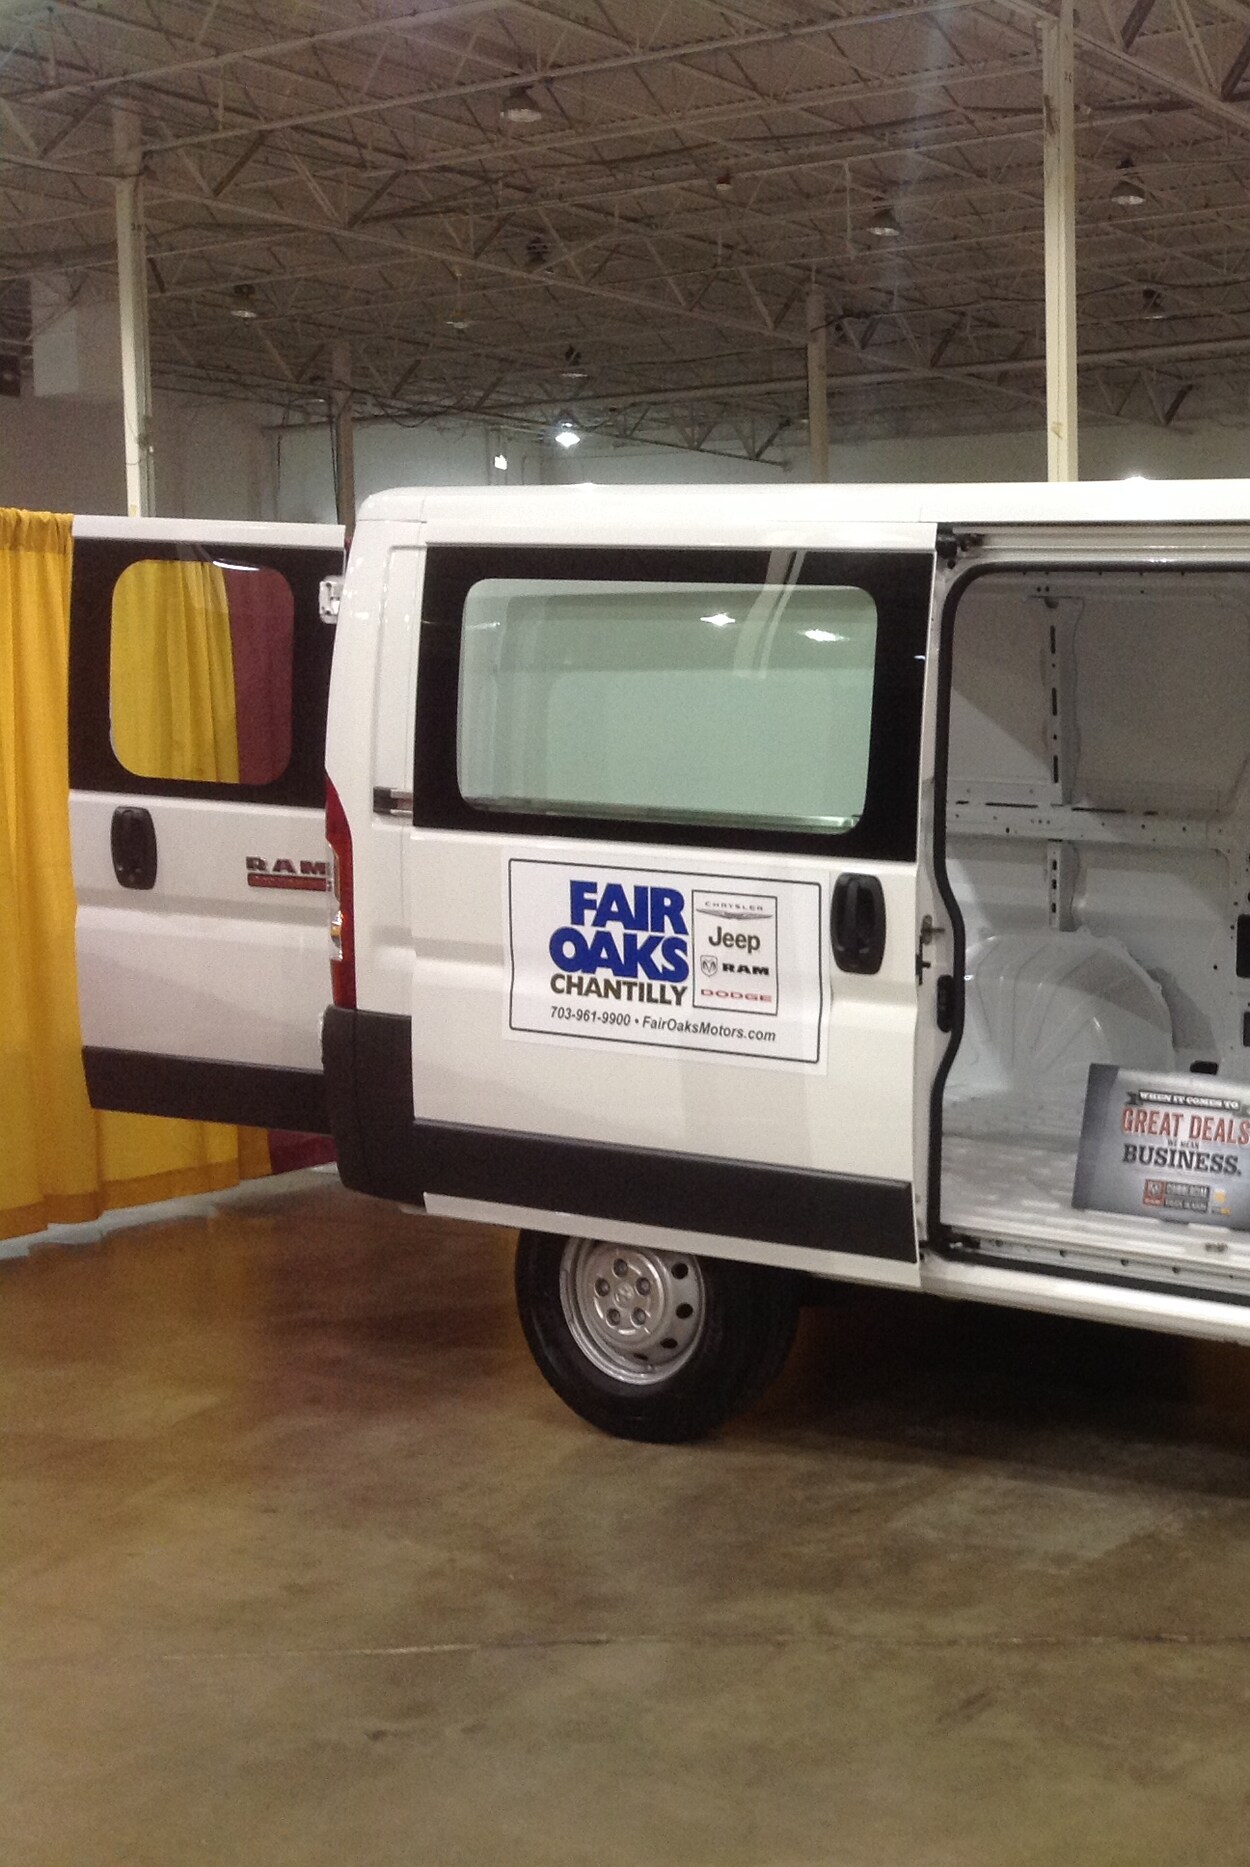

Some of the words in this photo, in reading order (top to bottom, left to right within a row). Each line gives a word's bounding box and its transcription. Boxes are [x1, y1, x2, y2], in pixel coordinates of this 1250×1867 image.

[246, 856, 329, 875] RAM
[570, 880, 689, 934] FAIR
[705, 901, 763, 911] CHRYSLER
[549, 926, 690, 983] OAKS
[709, 926, 761, 954] Jeep
[722, 963, 769, 975] RAM
[550, 974, 687, 1006] CHANTILLY
[701, 989, 772, 1002] DODGE
[551, 1006, 631, 1027] 703-961-9900
[642, 1016, 776, 1042] FairOaksMotors.com
[1140, 1091, 1171, 1101] WHEN
[1173, 1094, 1186, 1104] IT
[1186, 1096, 1222, 1107] COMES
[1223, 1100, 1240, 1109] TO
[1122, 1107, 1183, 1138] GREAT
[1122, 1143, 1242, 1176] BUSINESS.
